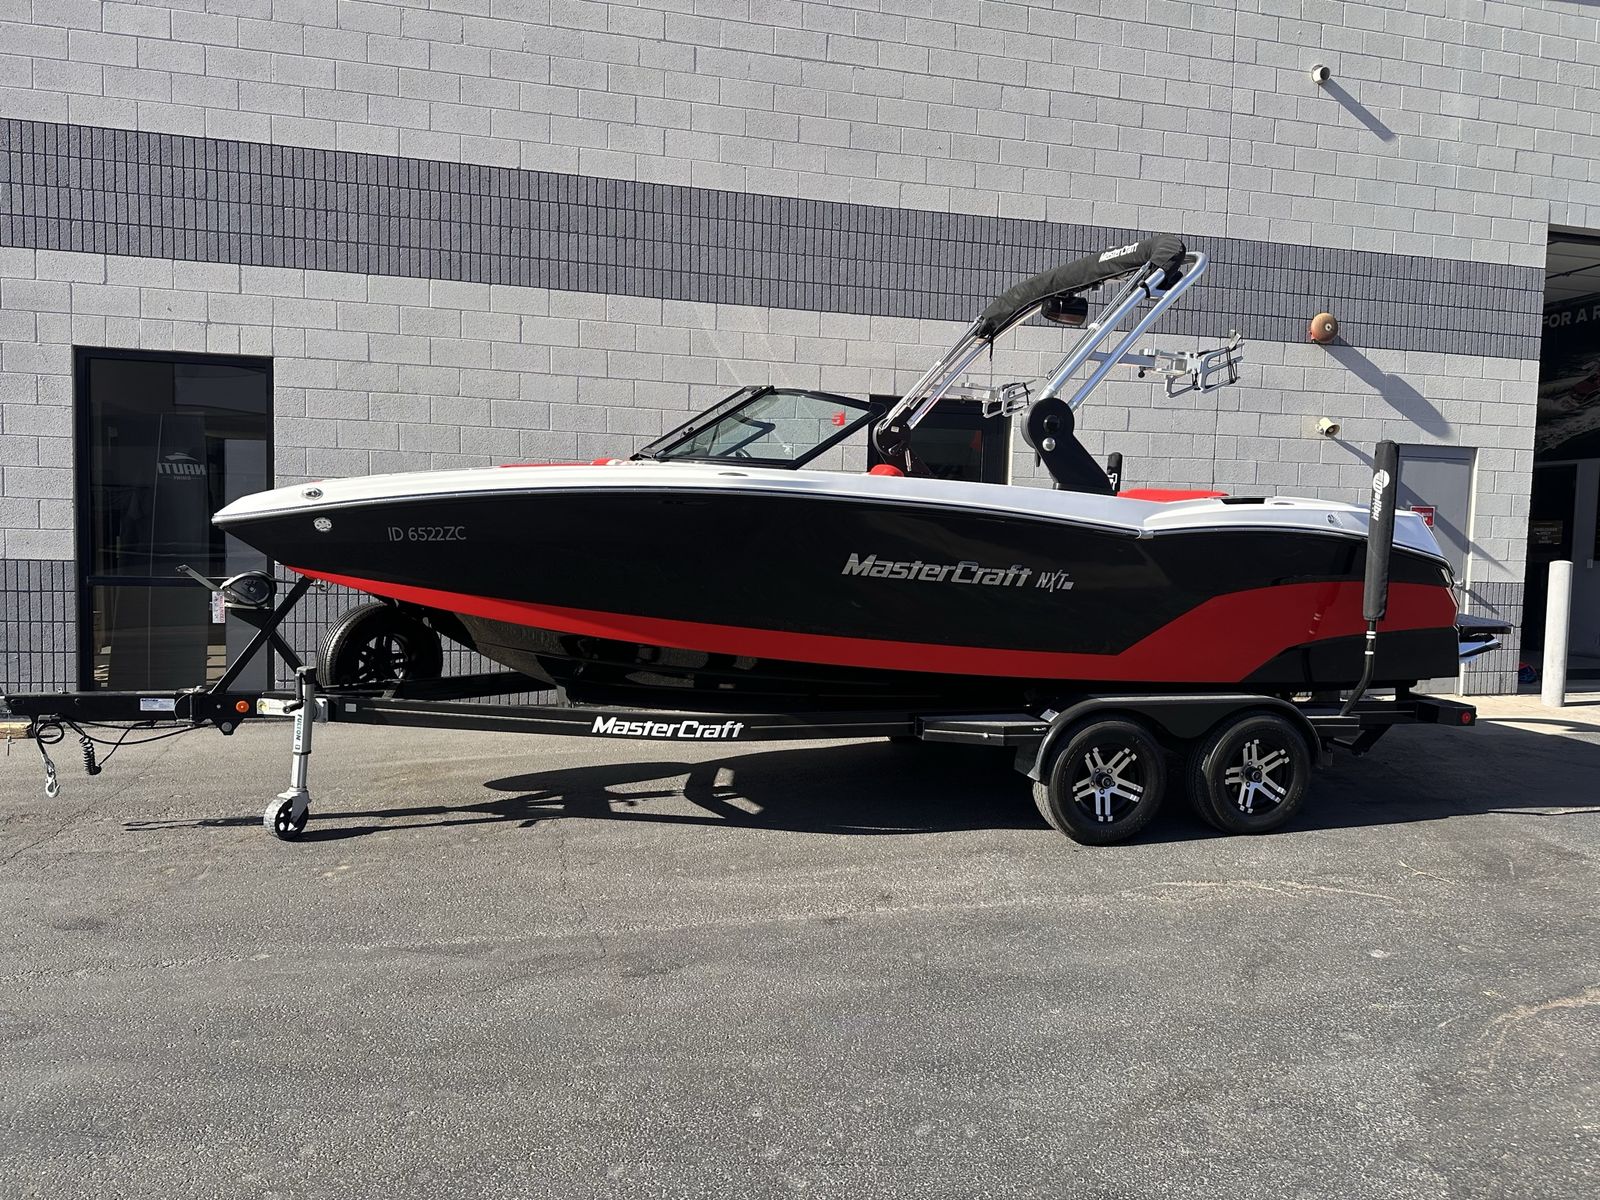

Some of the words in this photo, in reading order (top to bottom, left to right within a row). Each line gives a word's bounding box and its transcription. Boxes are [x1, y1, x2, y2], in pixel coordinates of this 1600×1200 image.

[1099, 242, 1139, 262] MasterCraft
[1576, 308, 1588, 323] A
[387, 527, 404, 541] ID
[408, 526, 467, 541] 6522ZC
[841, 553, 1033, 587] MasterCraft
[1035, 570, 1069, 592] NXT
[591, 716, 744, 738] MasterCraft
